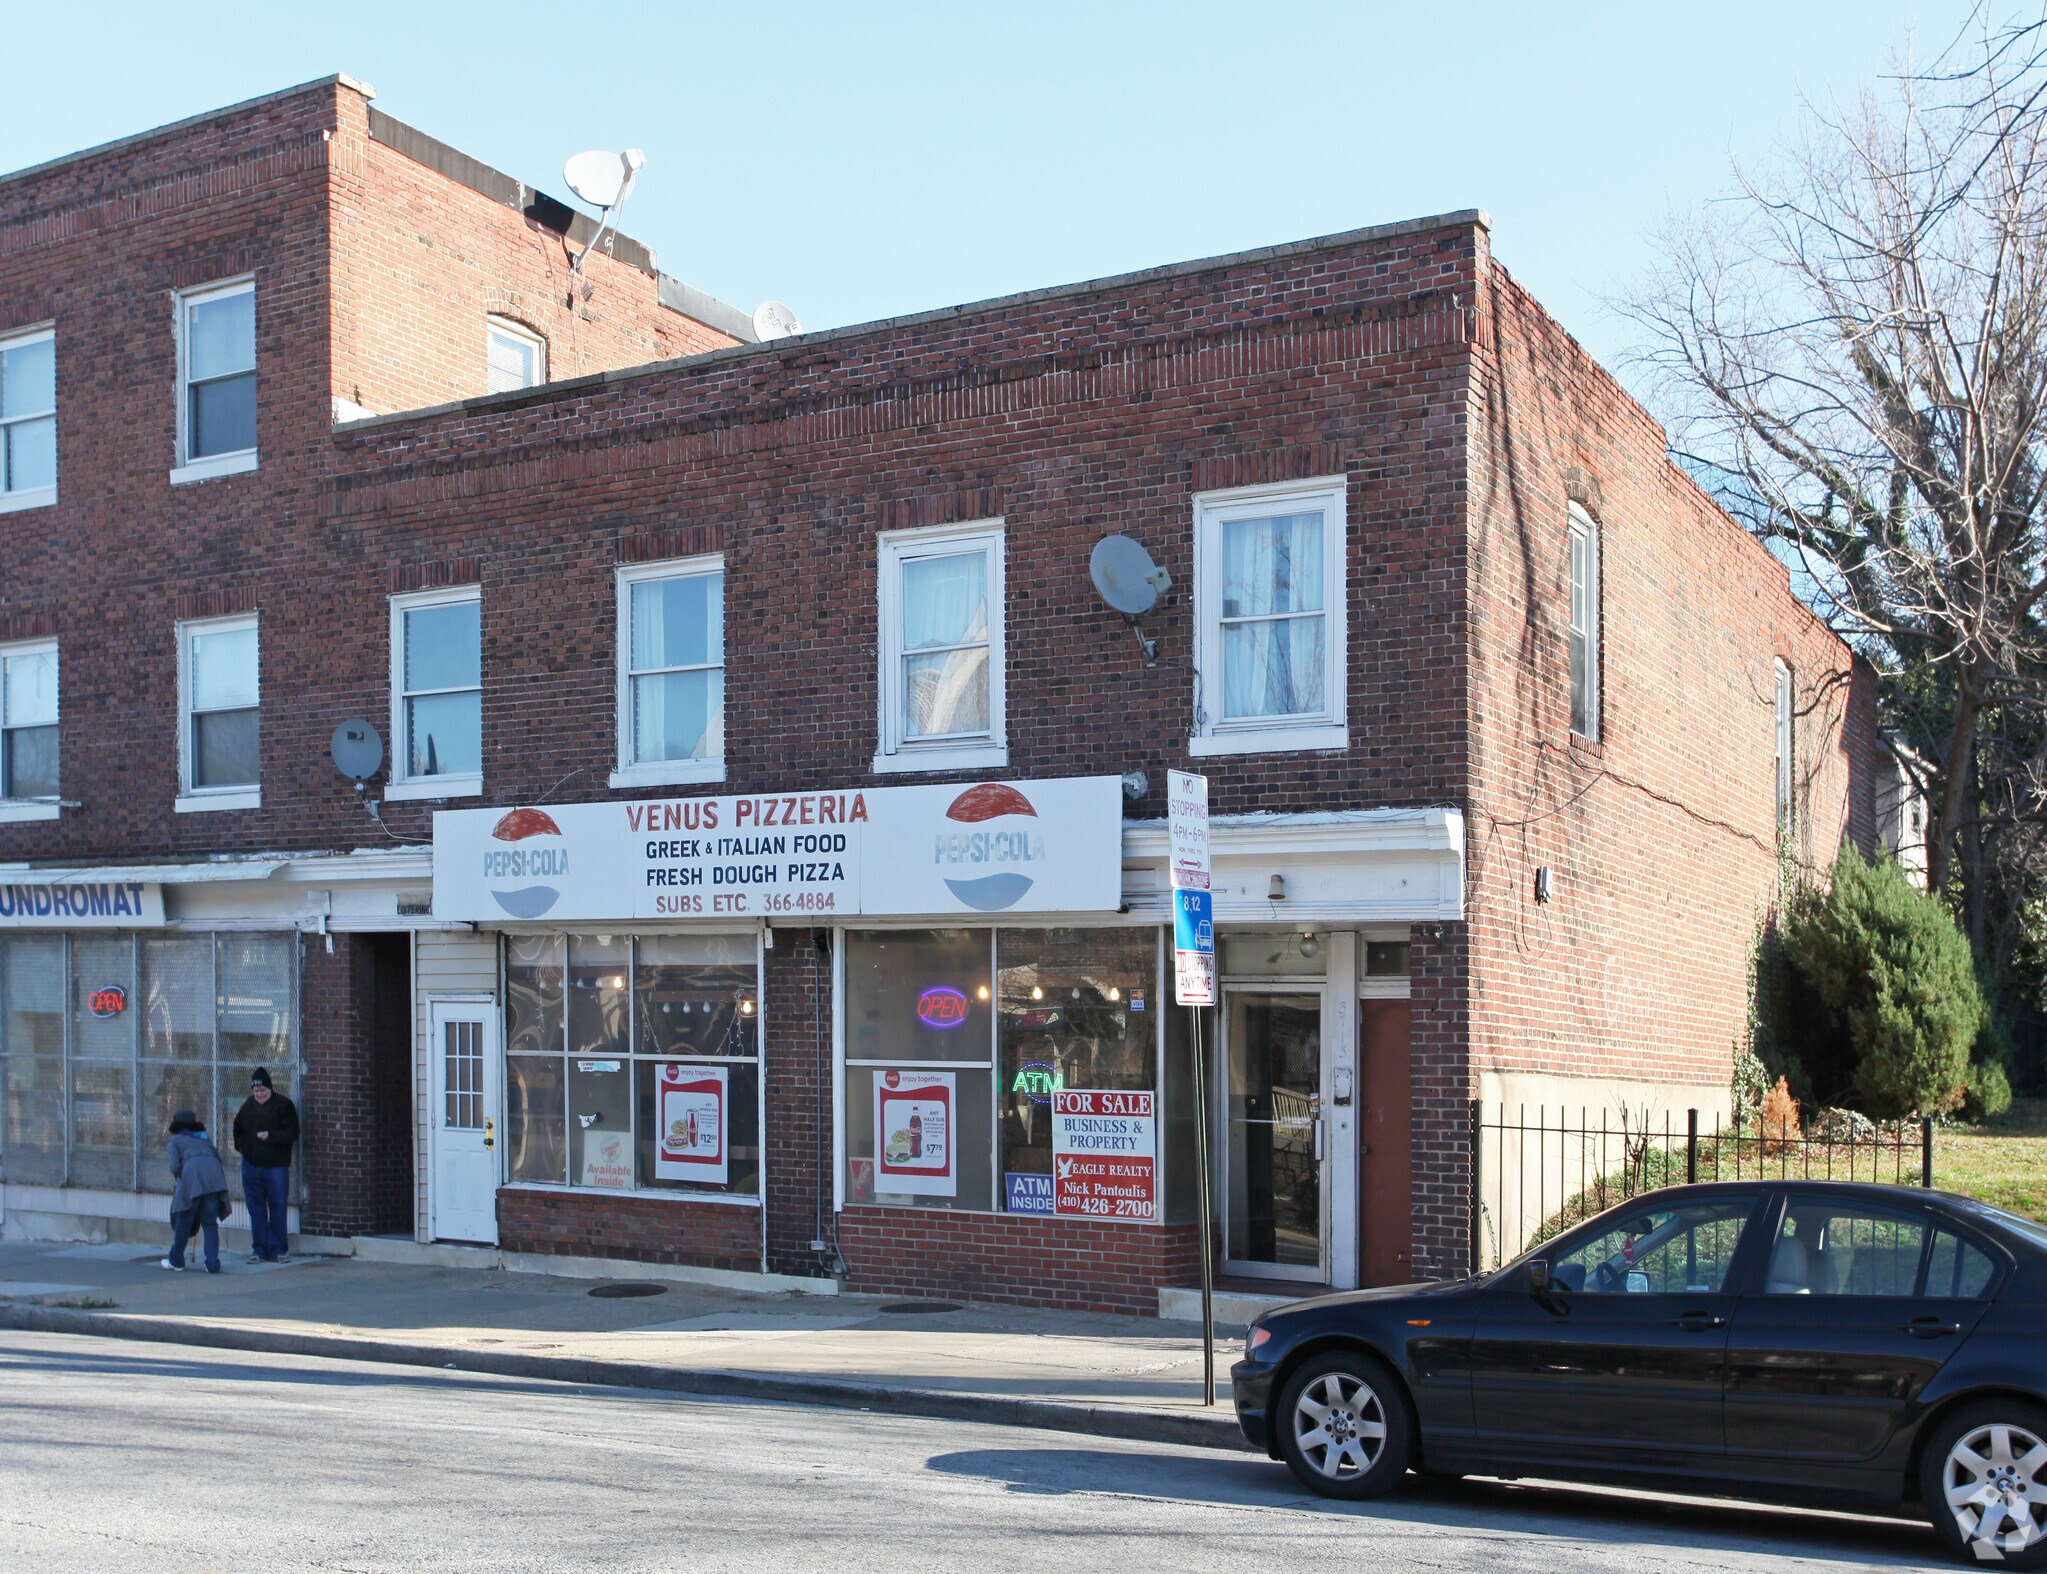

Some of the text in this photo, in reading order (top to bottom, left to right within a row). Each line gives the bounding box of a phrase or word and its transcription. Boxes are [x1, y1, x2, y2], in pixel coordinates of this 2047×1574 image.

[1183, 778, 1194, 794] NO
[626, 793, 869, 832] VENUS PIZZERIA
[1171, 799, 1206, 820] STOPPING
[646, 834, 846, 858] GREEK & ITALIAN FOOD
[647, 863, 845, 886] FRESH DOUGH PIZZA
[0, 884, 144, 917] UNDROMAT
[656, 895, 703, 913] SUBS
[1187, 955, 1213, 972] STOPPING
[88, 991, 123, 1011] OPEN
[917, 996, 967, 1018] OPEN
[695, 1069, 716, 1077] together
[1012, 1071, 1064, 1093] ATM
[1056, 1093, 1151, 1114] FOR SALE
[1064, 1118, 1143, 1134] BUSINESS &
[1069, 1135, 1138, 1150] PROPERTY
[587, 1163, 632, 1176] Available
[1072, 1163, 1151, 1177] EAGLE REALTY
[594, 1175, 624, 1187] Inside
[1013, 1177, 1051, 1196] ATM
[1064, 1181, 1147, 1198] Nick Pantoulis
[1011, 1196, 1053, 1210] INSIDE
[1057, 1195, 1152, 1217] (410) 426-2700
